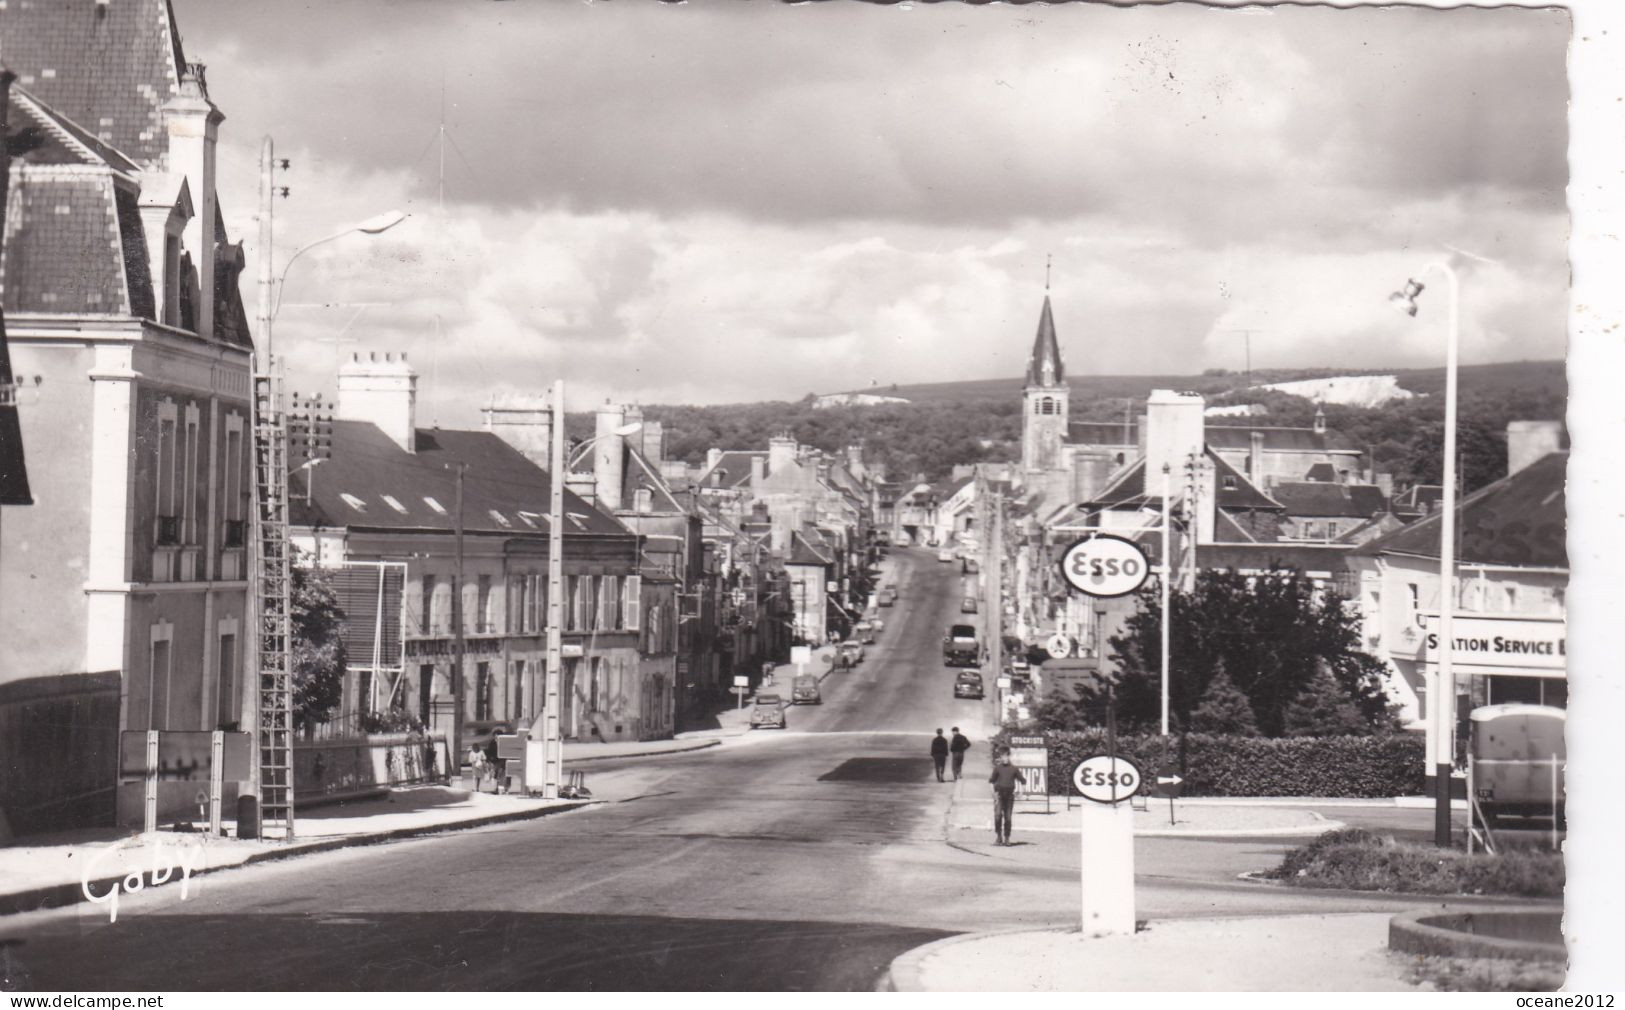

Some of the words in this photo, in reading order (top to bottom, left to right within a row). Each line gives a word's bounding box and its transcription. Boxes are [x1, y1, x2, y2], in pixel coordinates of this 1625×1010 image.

[1072, 552, 1139, 576] Esso
[1494, 636, 1553, 654] SERVICE
[1012, 737, 1044, 745] STOCKISTE
[1080, 767, 1134, 787] Esso
